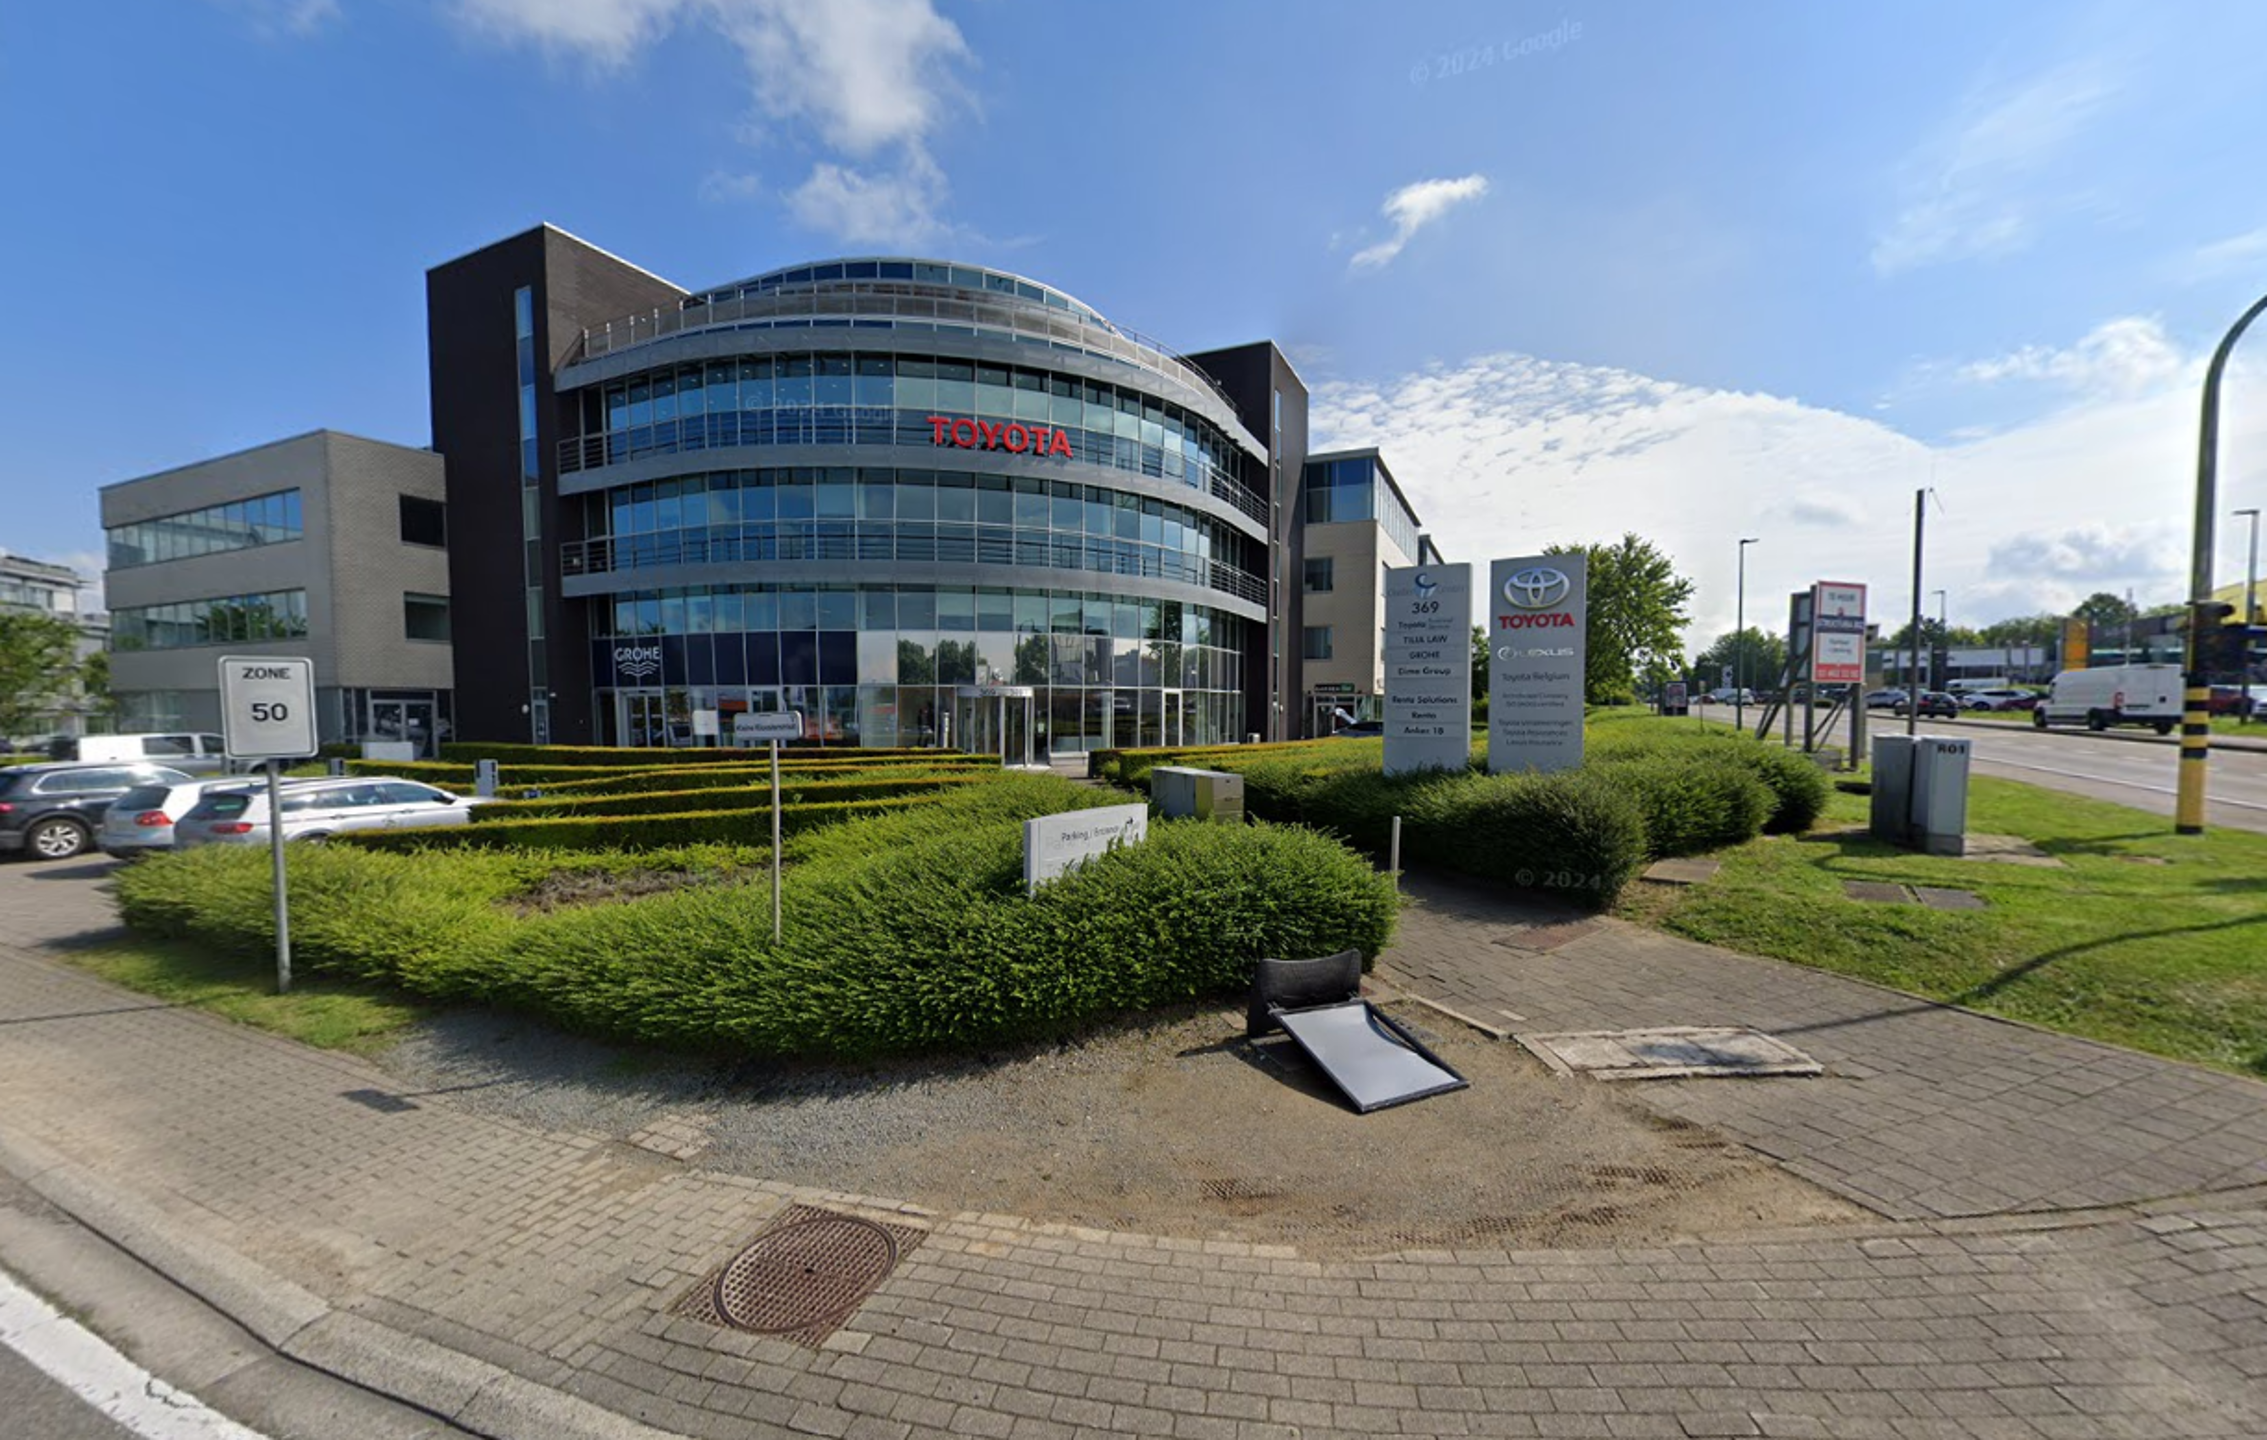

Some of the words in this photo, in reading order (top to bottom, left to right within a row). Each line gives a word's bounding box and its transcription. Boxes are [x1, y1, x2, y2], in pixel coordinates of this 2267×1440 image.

[926, 415, 1074, 459] TOYOTA
[1411, 601, 1440, 615] 369
[1498, 612, 1576, 630] TOYOTA
[1426, 634, 1448, 644] LAW
[613, 646, 661, 661] GROHE
[1409, 651, 1441, 660] GROHE
[1518, 647, 1575, 657] LEXUS
[241, 667, 291, 680] ZONE
[1422, 666, 1452, 676] Group
[1501, 672, 1531, 682] Toyota
[1532, 671, 1571, 682] Belgium
[1417, 695, 1458, 704] Solutions
[251, 703, 289, 722] 50
